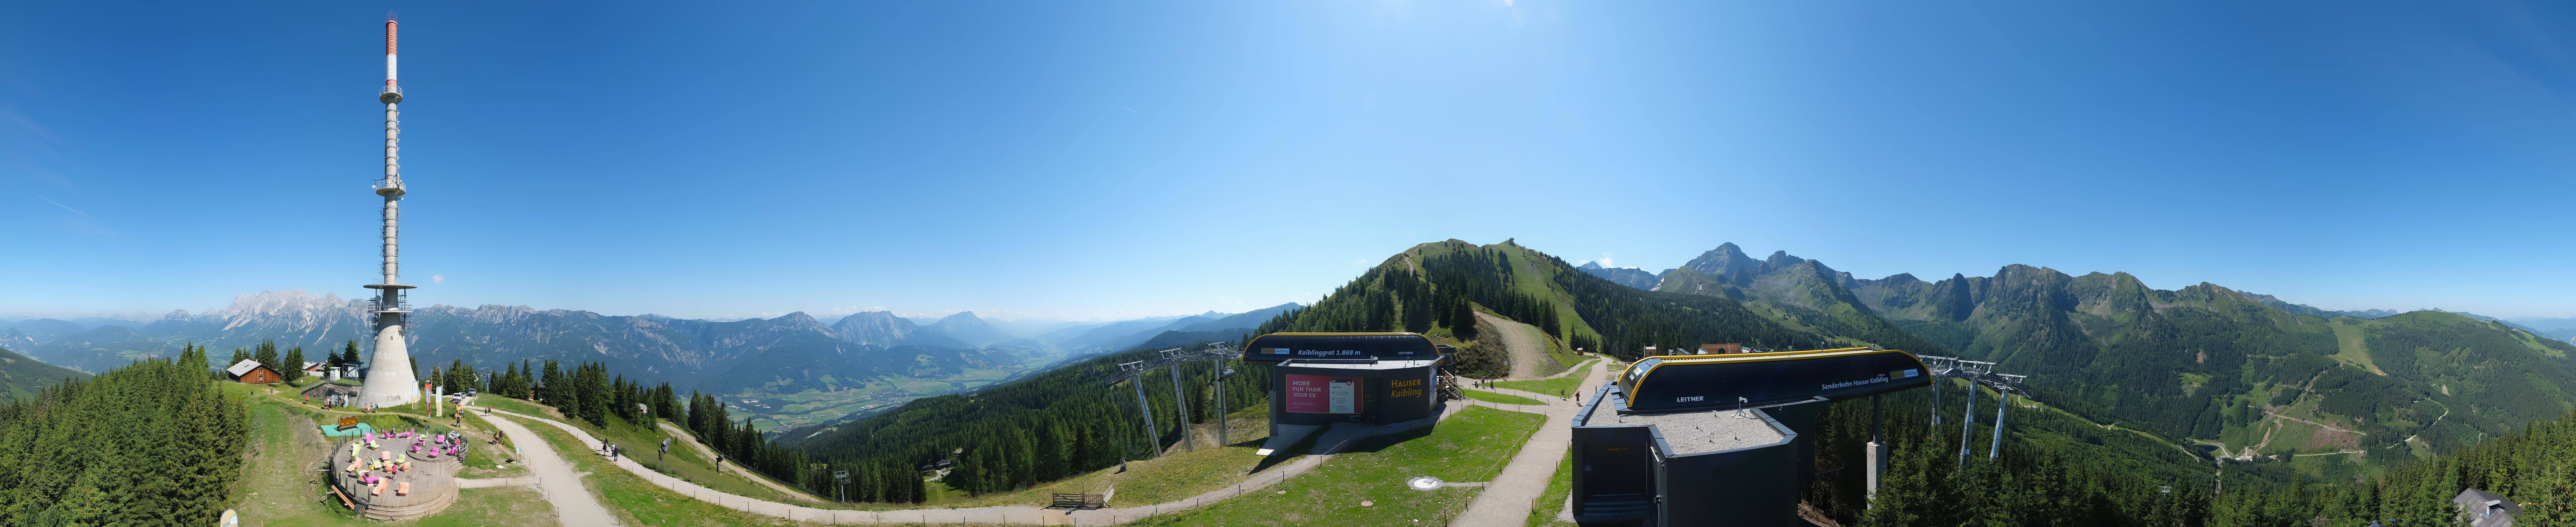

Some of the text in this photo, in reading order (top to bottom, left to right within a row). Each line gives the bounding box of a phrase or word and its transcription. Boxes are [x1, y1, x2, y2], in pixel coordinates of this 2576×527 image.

[1392, 379, 1421, 388] HAUSER
[1822, 381, 1852, 390] Senderbahn
[1391, 388, 1422, 398] Kaibling
